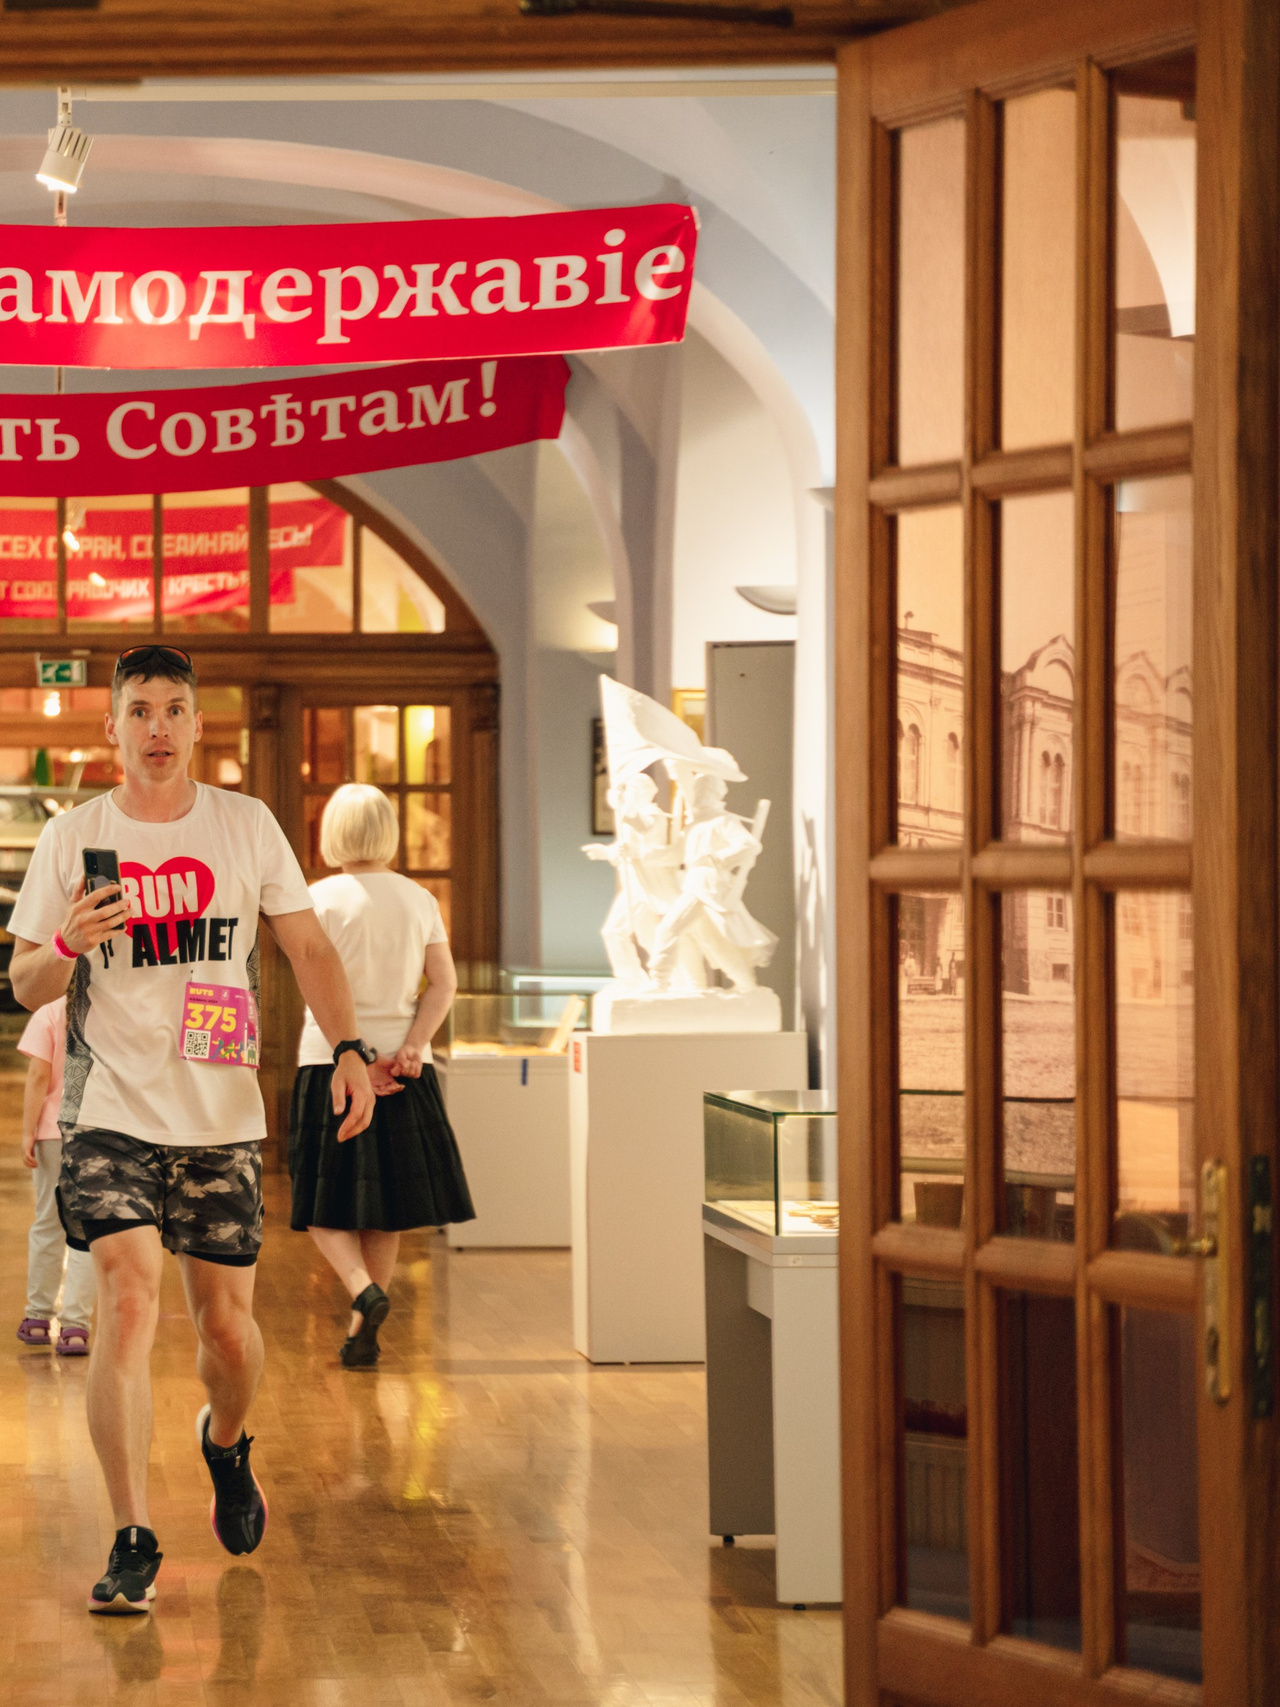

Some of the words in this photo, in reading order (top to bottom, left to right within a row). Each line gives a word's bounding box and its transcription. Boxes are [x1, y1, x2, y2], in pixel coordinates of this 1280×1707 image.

[106, 360, 498, 459] Совѣтам!
[121, 870, 199, 919] RUN
[131, 917, 239, 969] ALMET
[184, 1002, 237, 1033] 375
